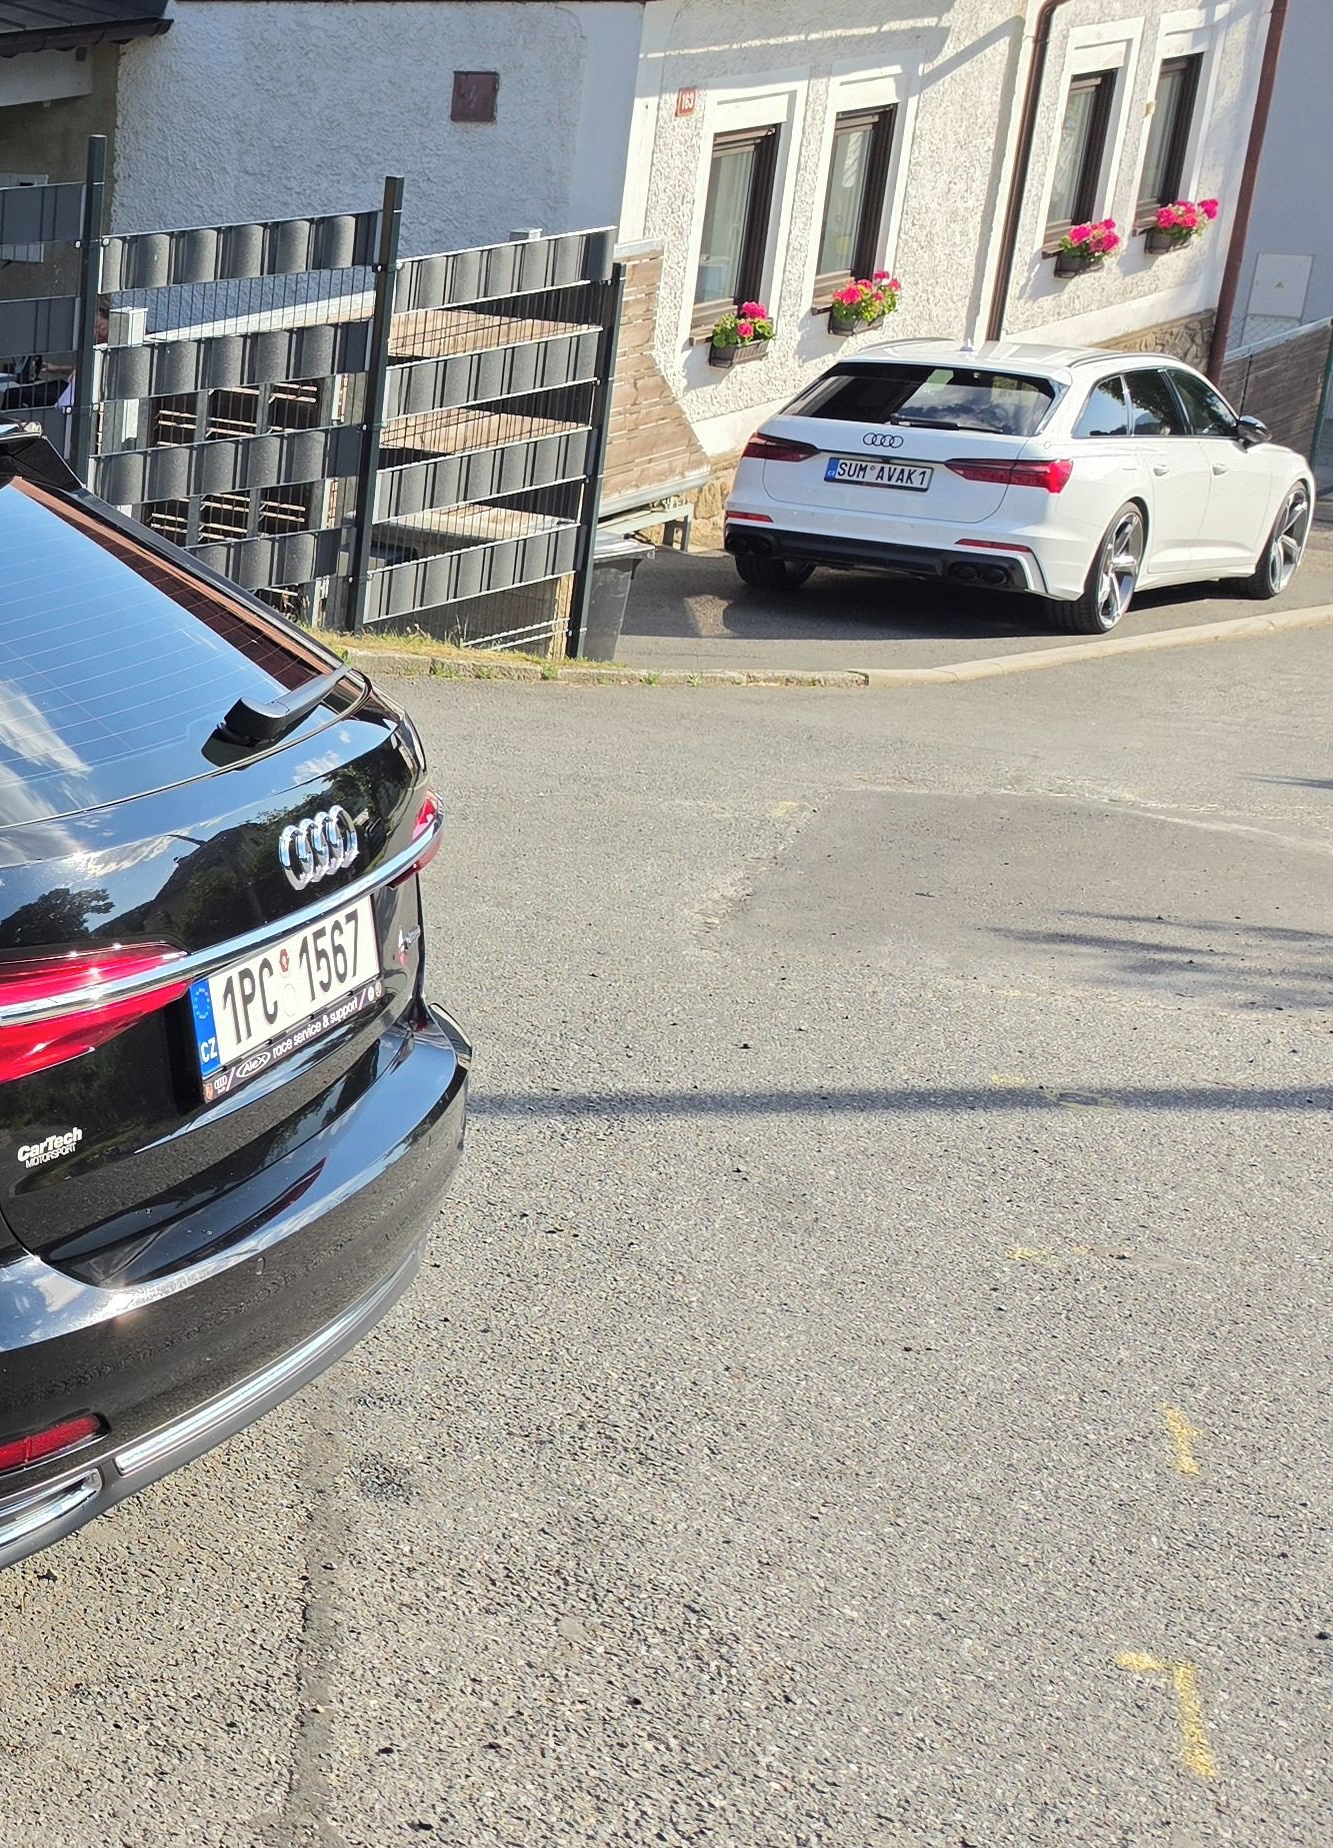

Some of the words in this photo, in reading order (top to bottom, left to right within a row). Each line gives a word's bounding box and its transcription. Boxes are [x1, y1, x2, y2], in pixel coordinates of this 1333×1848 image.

[837, 462, 868, 480] SUM
[875, 465, 927, 486] AVAK1
[221, 957, 279, 1046] 1PC
[298, 908, 359, 1002] 1567
[272, 1040, 293, 1059] race
[293, 1020, 322, 1046] service
[322, 1014, 330, 1028] &
[329, 996, 358, 1023] support
[200, 1037, 218, 1063] CZ
[17, 1126, 83, 1162] CarTech
[25, 1141, 77, 1169] MOTORSPORT
